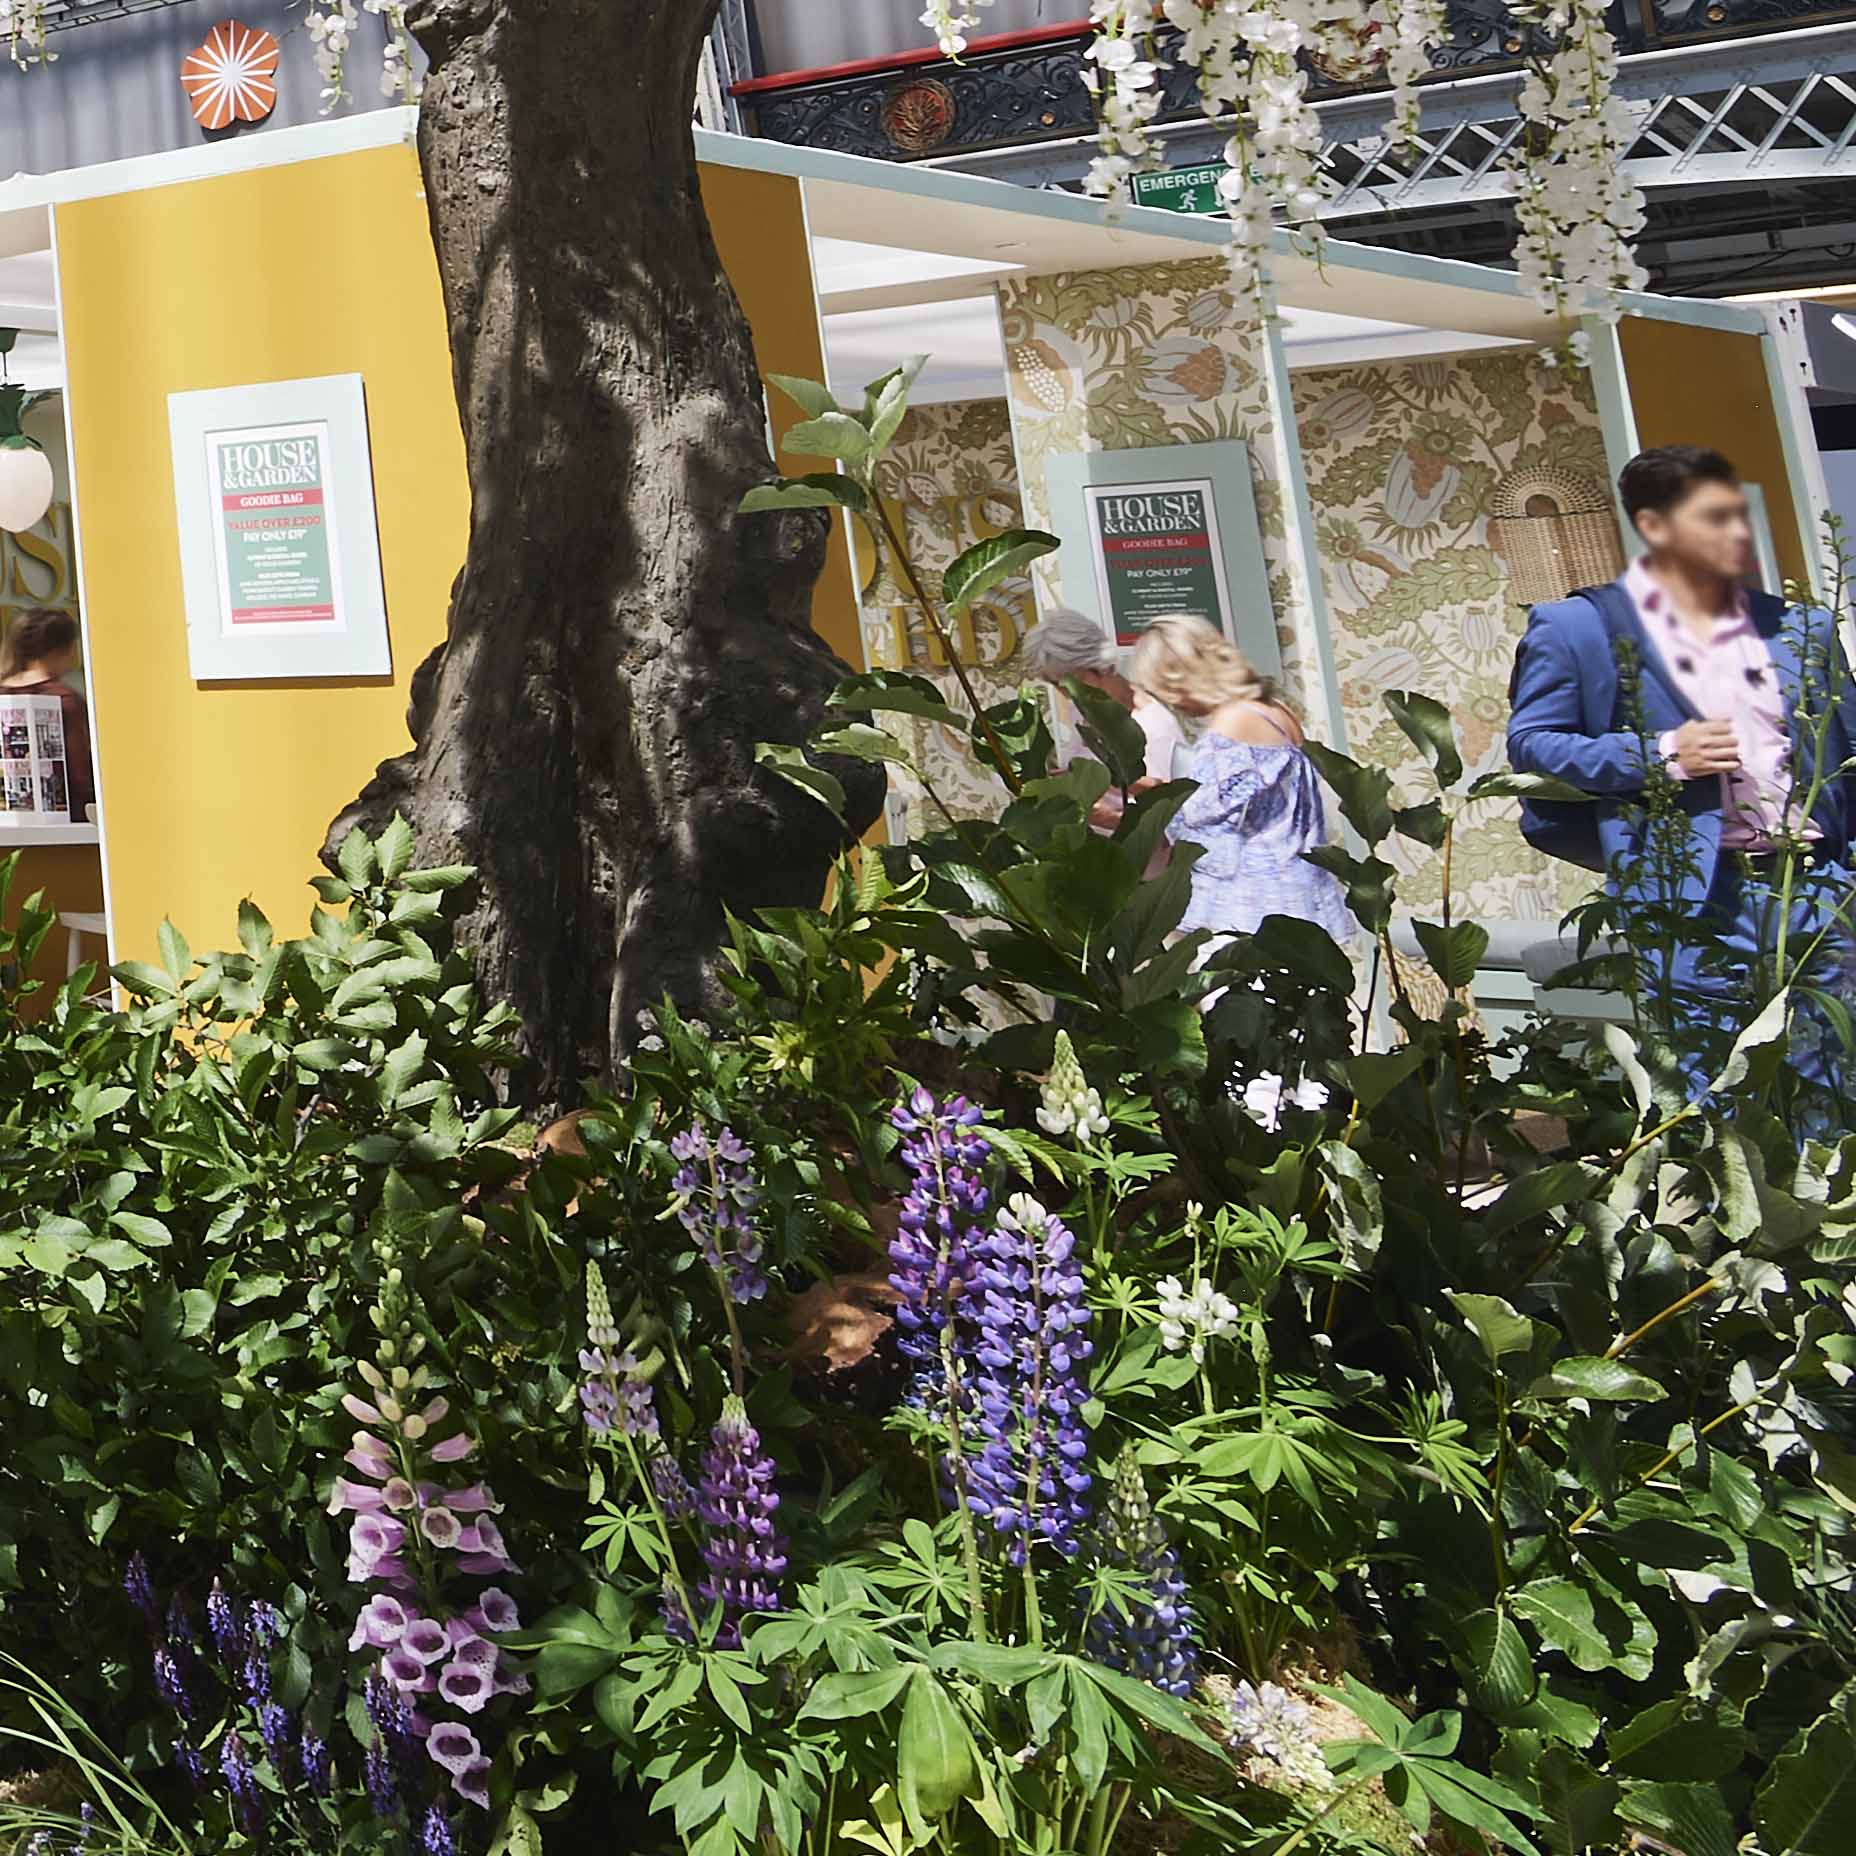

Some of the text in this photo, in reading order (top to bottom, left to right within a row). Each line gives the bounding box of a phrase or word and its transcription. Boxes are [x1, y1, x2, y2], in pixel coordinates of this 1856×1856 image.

[1139, 168, 1232, 192] EMERGEN
[222, 439, 317, 473] HOUSE
[223, 464, 317, 489] &GARDEN
[240, 492, 304, 507] GOODIE BAG
[1103, 493, 1200, 520] HOUSE
[1104, 514, 1200, 534] &GARDEN
[1121, 537, 1188, 549] GOODIE BAG
[1126, 569, 1144, 578] PAY
[1145, 568, 1171, 578] ONLY
